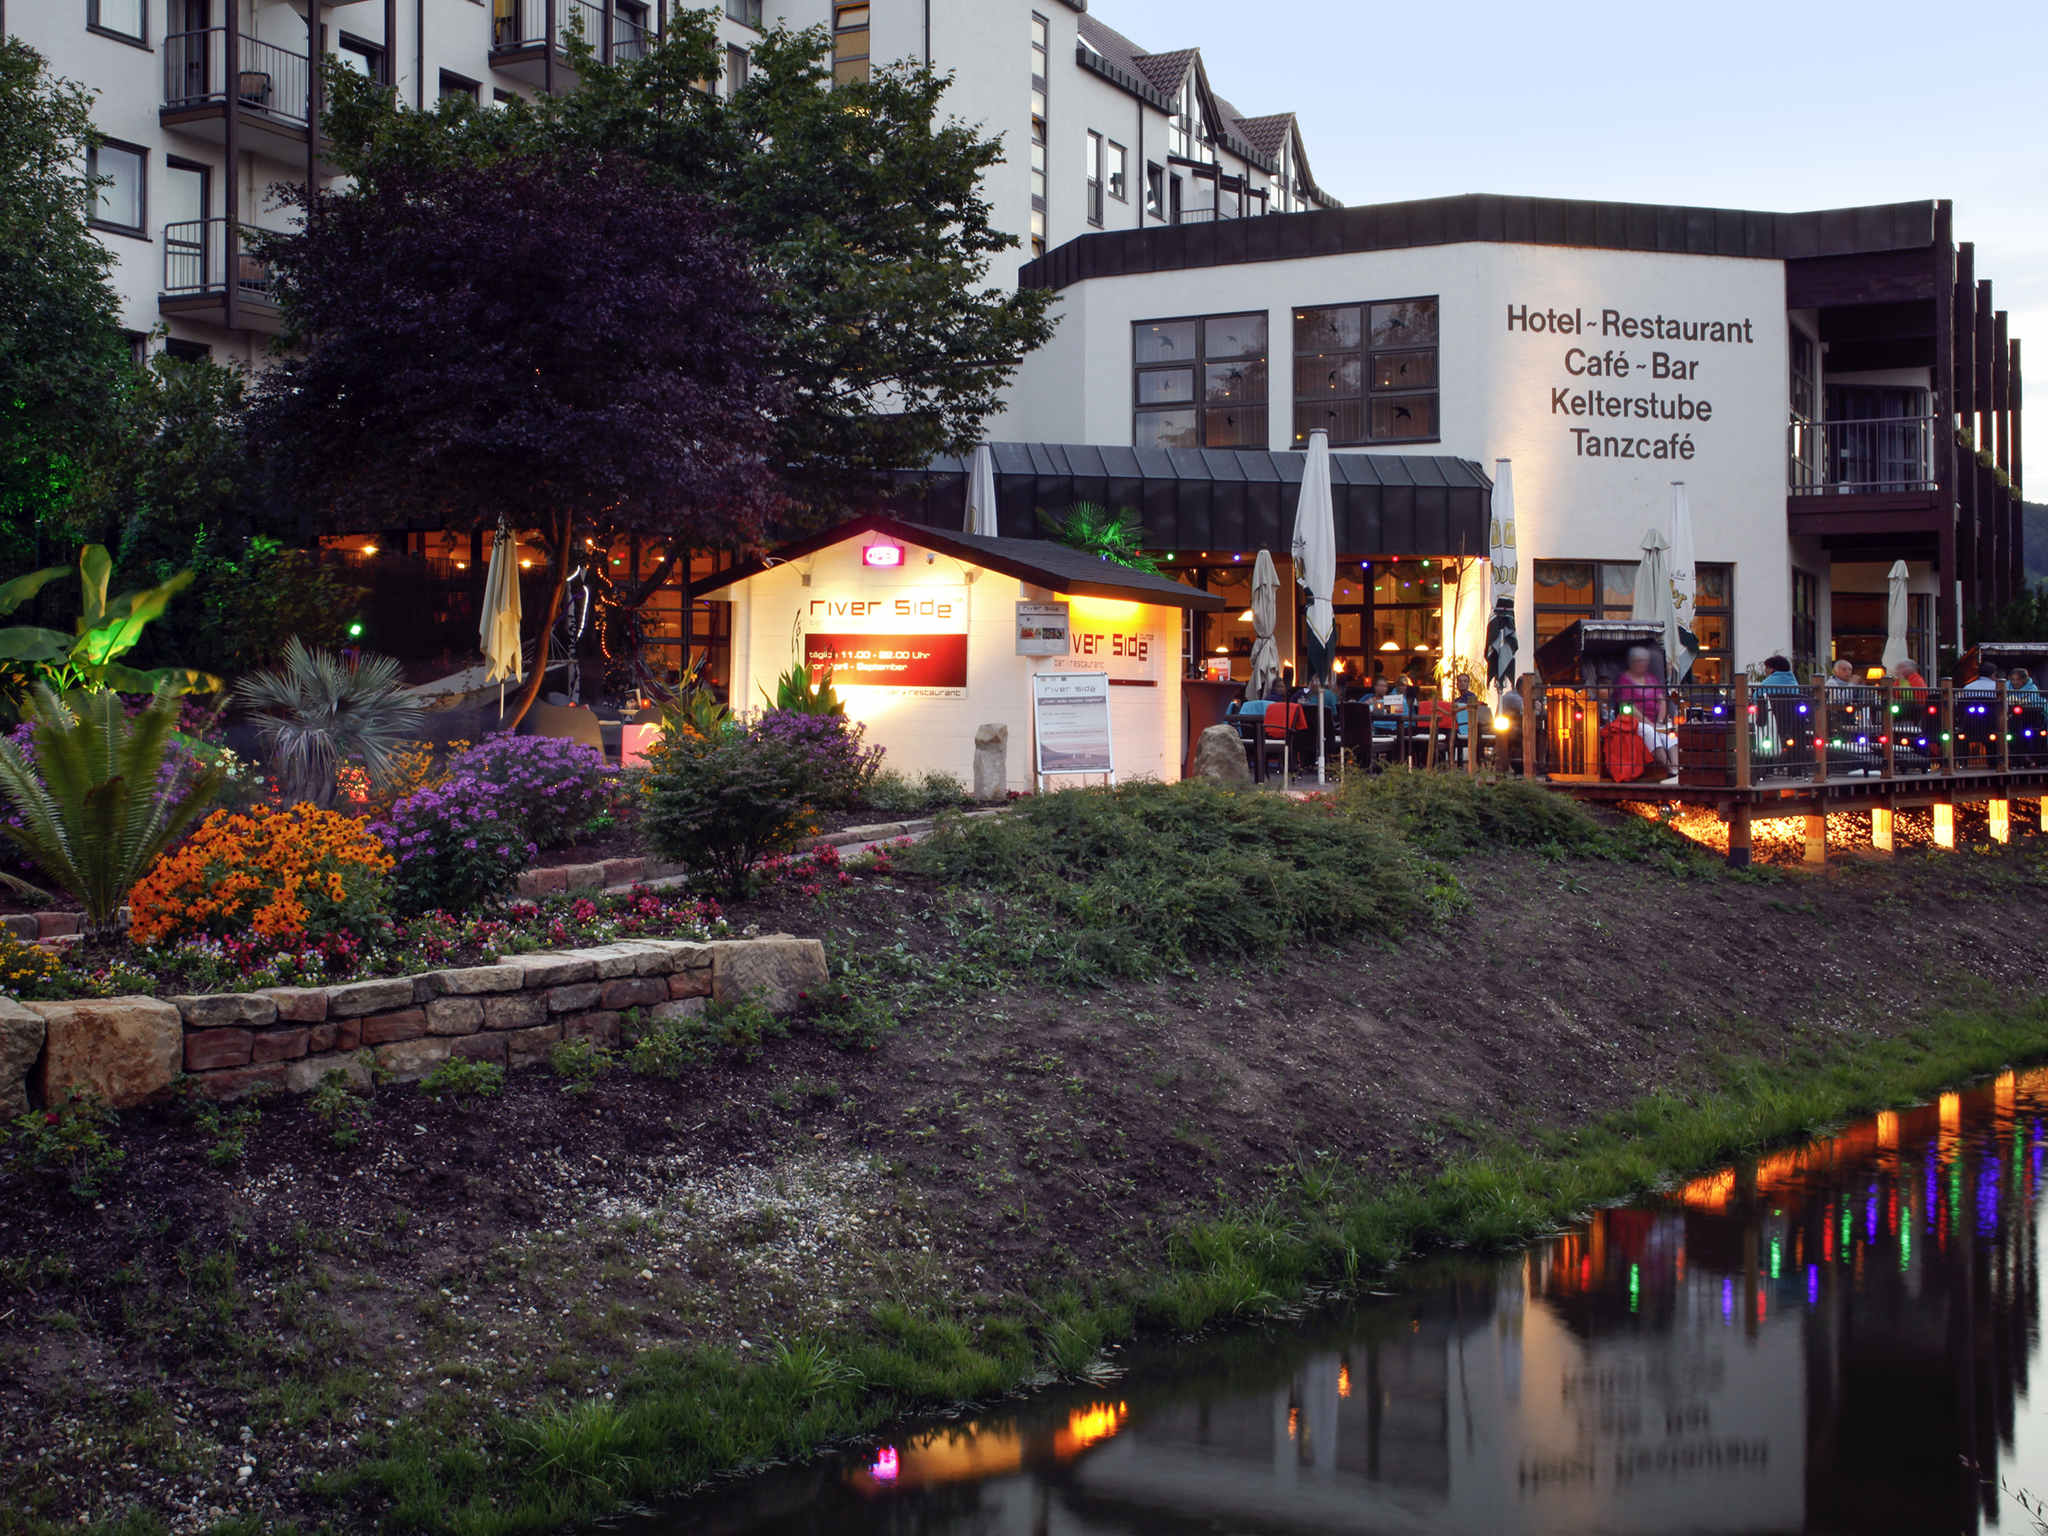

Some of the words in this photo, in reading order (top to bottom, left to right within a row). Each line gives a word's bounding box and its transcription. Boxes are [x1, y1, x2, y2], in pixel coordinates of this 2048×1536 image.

[1507, 304, 1581, 334] Hotel
[1602, 309, 1754, 343] Restaurant
[1564, 348, 1629, 377] Café
[1652, 351, 1699, 380] Bar
[1551, 387, 1712, 422] Kelterstube
[1569, 427, 1695, 460] Tanzcafé
[1072, 633, 1104, 654] ver
